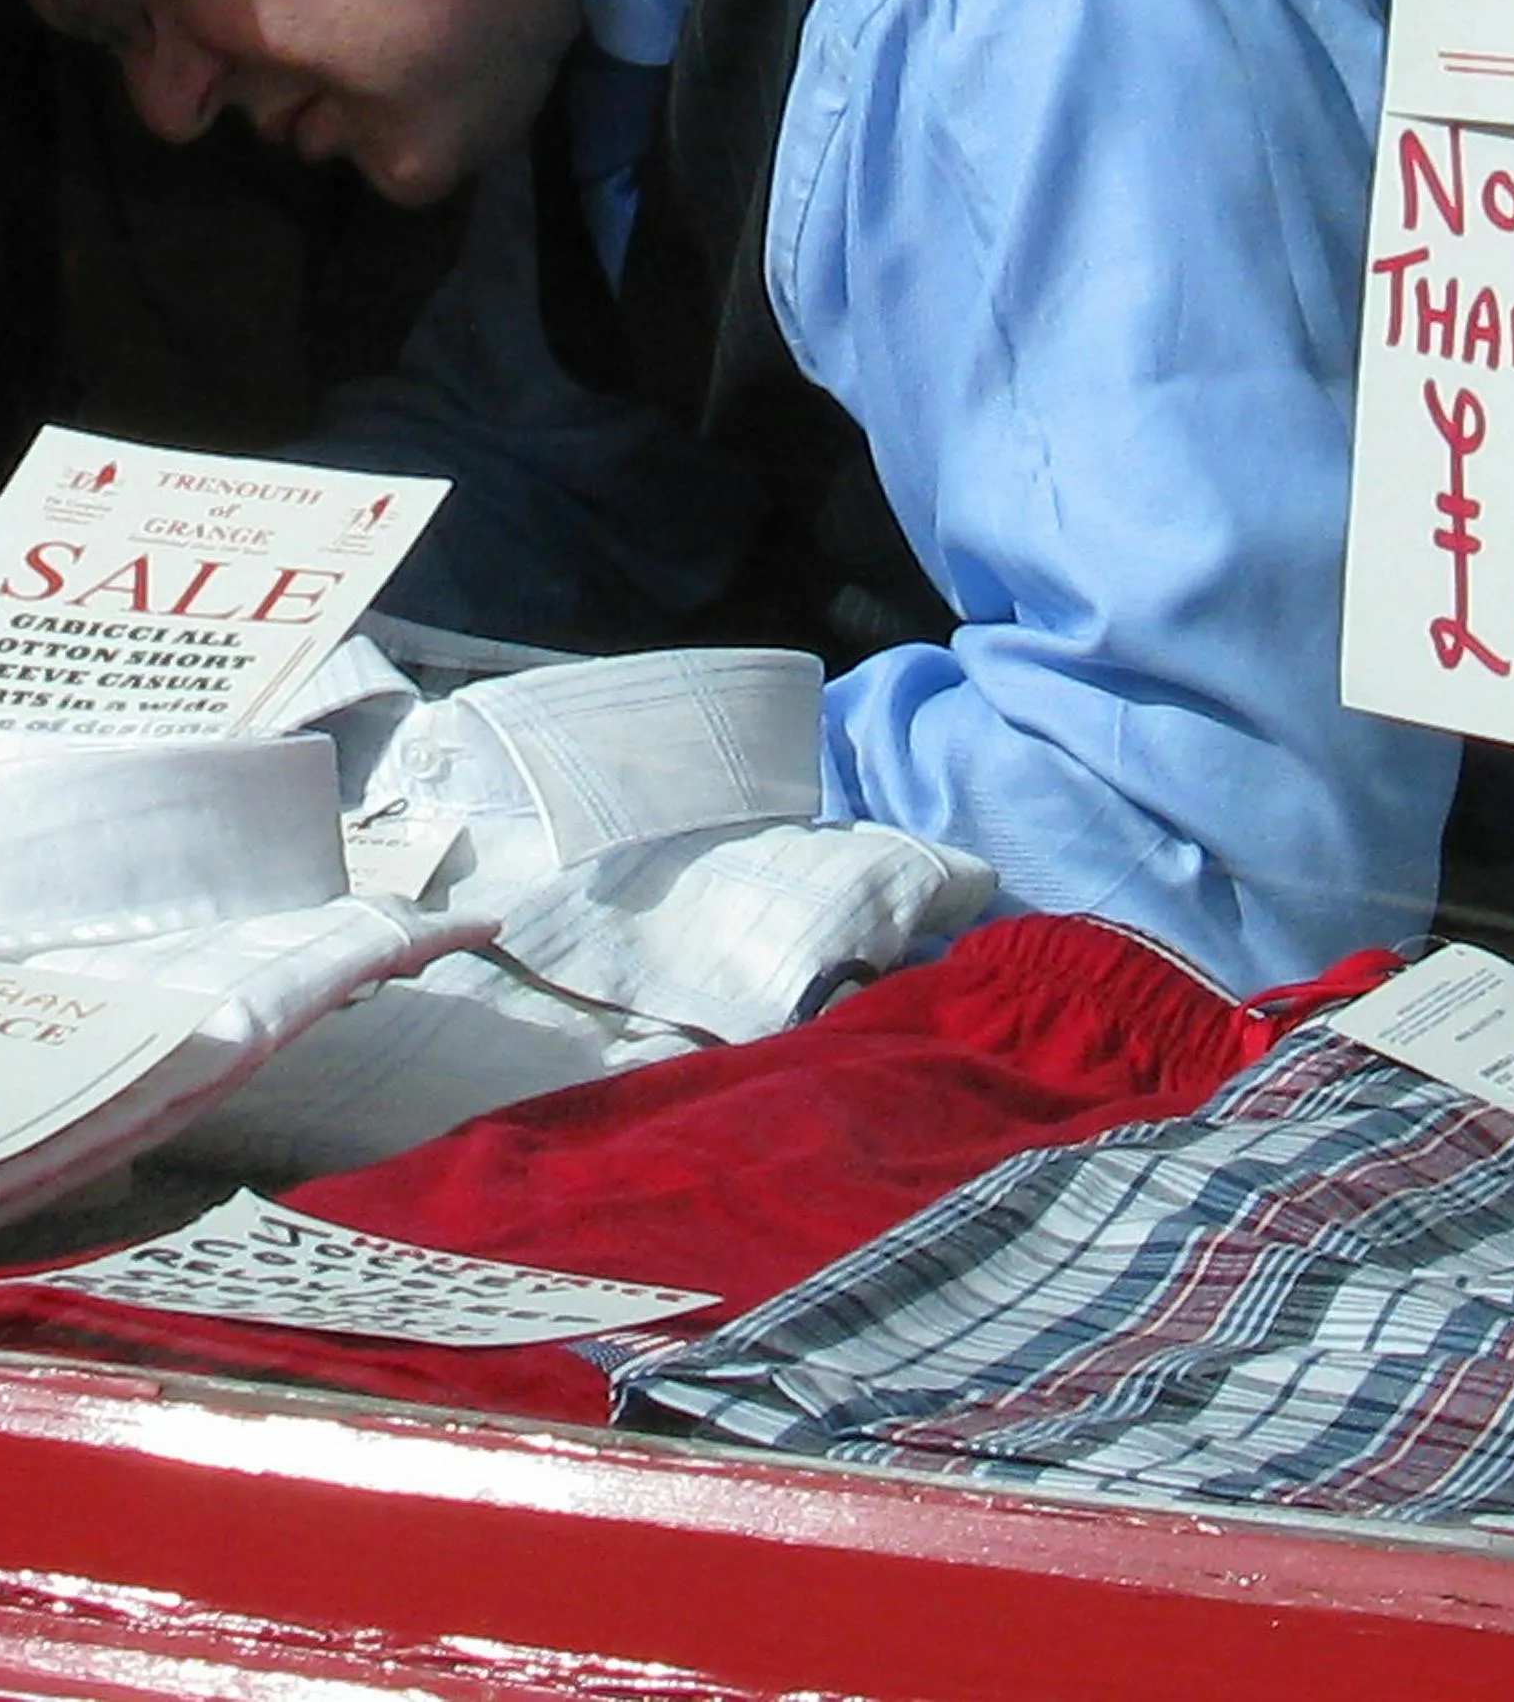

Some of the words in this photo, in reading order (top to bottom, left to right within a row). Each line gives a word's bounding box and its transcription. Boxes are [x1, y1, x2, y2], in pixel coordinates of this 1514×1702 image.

[157, 469, 322, 506] TRENOUTH
[208, 501, 242, 520] of
[142, 516, 276, 547] GRANGE
[171, 627, 245, 648] ALL
[130, 647, 257, 672] SHORT
[95, 670, 236, 693] CASUAL
[58, 692, 96, 713] in
[138, 696, 231, 715] wide
[25, 717, 69, 734] of
[71, 717, 224, 739] designs
[244, 1216, 573, 1293] JOCKEY
[183, 1237, 510, 1299] COTTON
